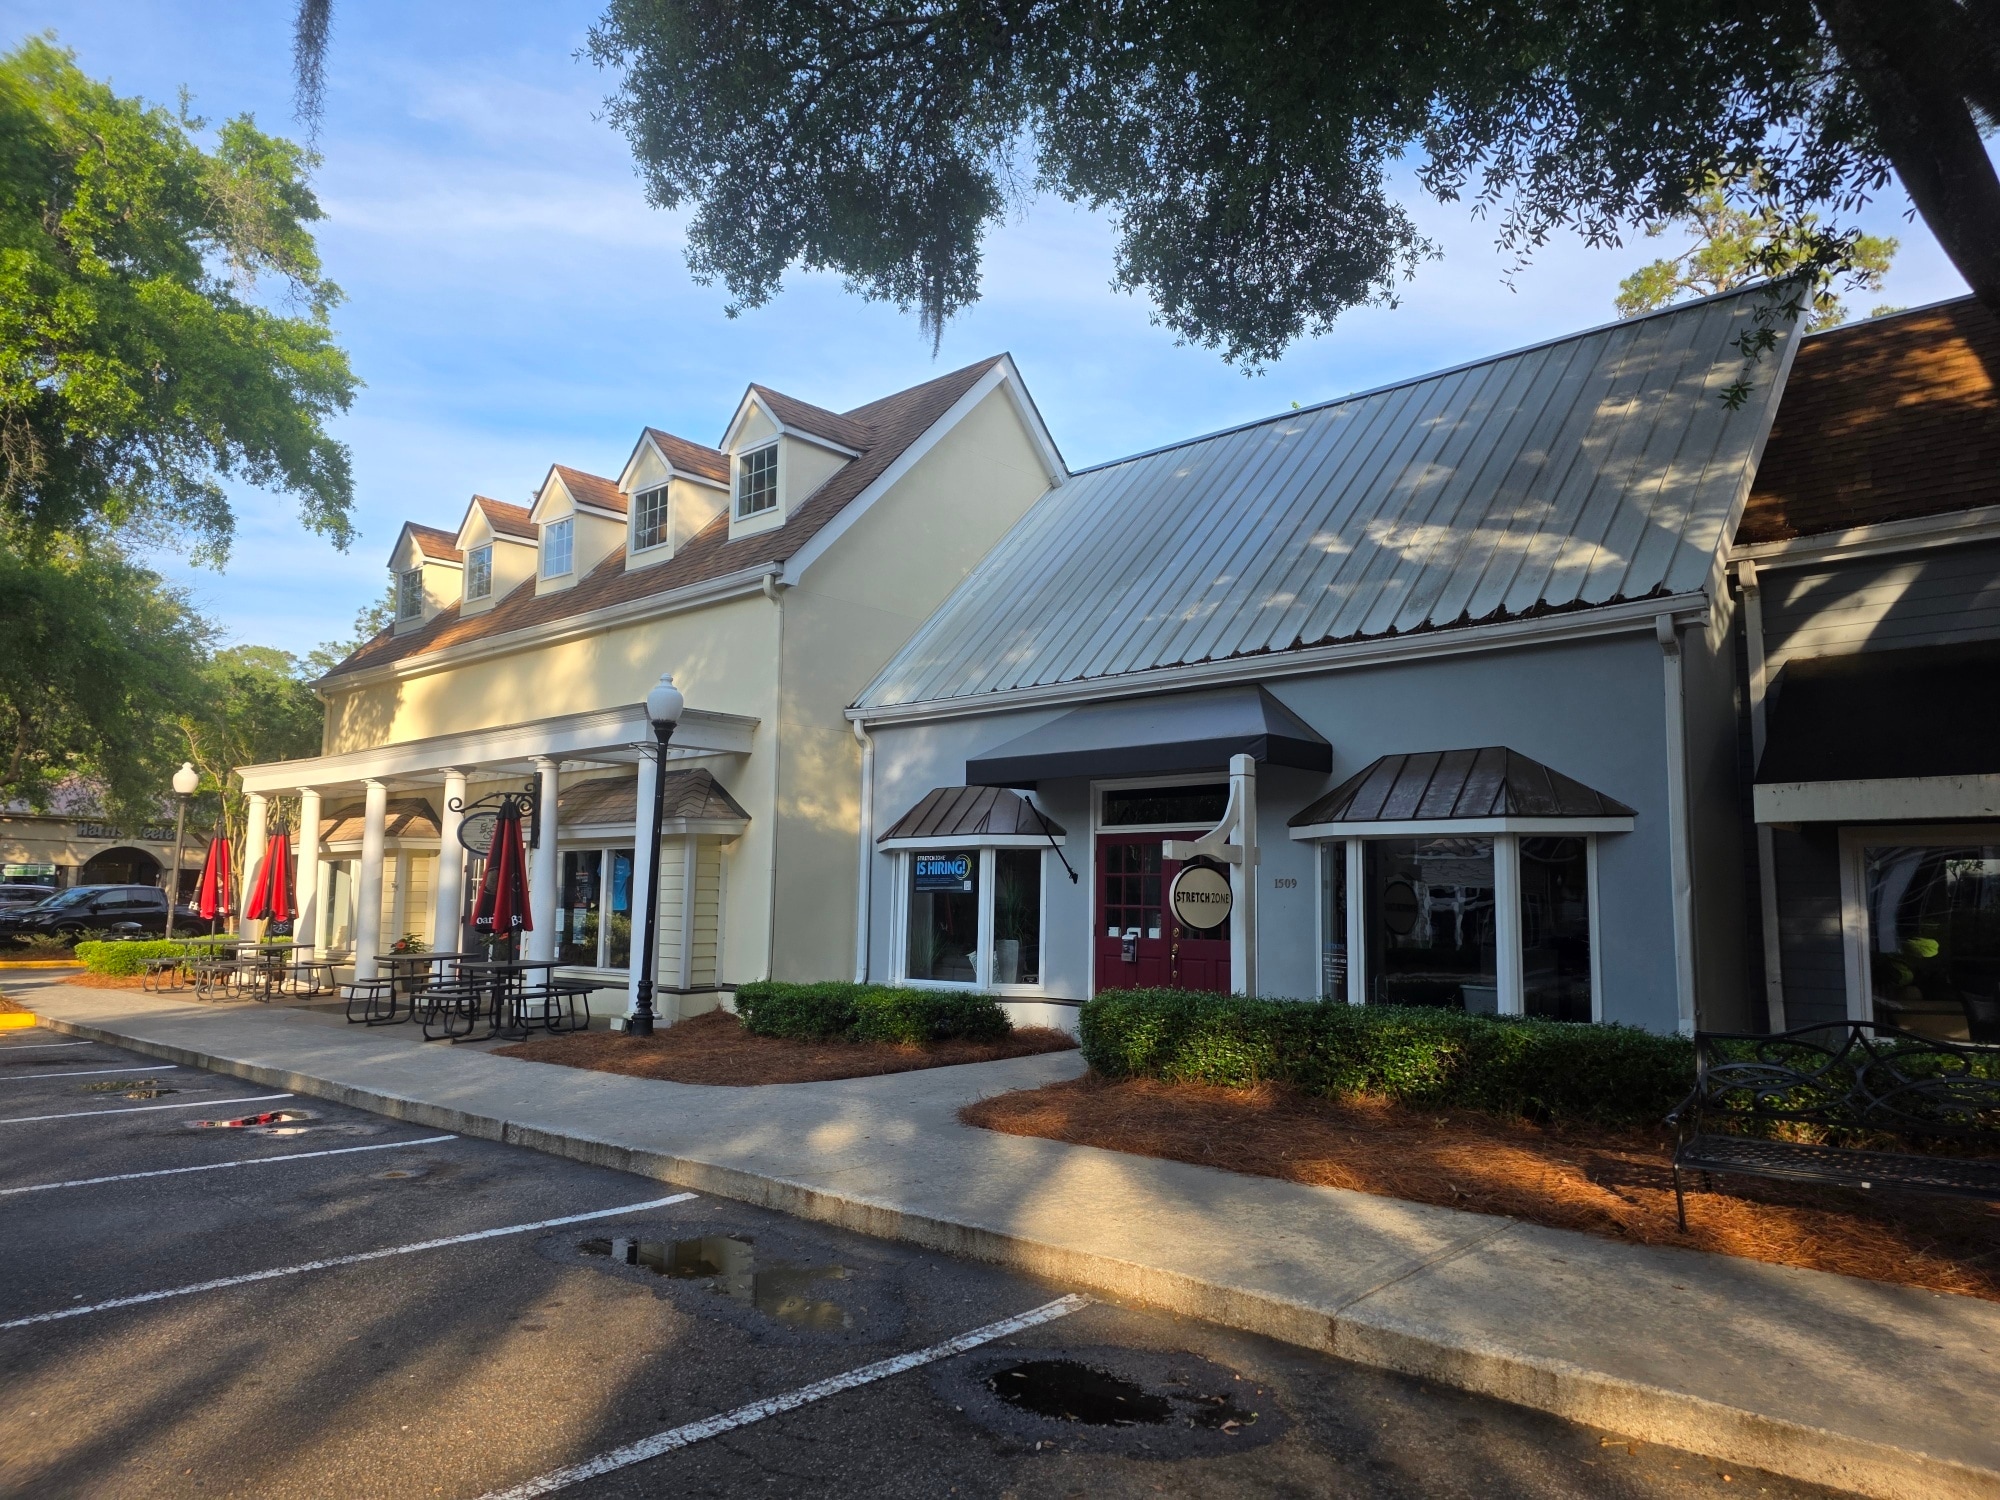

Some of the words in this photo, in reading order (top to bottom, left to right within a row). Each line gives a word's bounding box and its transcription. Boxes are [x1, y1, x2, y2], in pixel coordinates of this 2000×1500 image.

[77, 822, 125, 838] Harris
[140, 825, 178, 840] eeter
[916, 861, 927, 875] IS
[927, 860, 966, 875] HIRING!
[1274, 878, 1297, 889] 1509
[1176, 891, 1210, 904] STRETCH
[1211, 893, 1230, 904] ZONE
